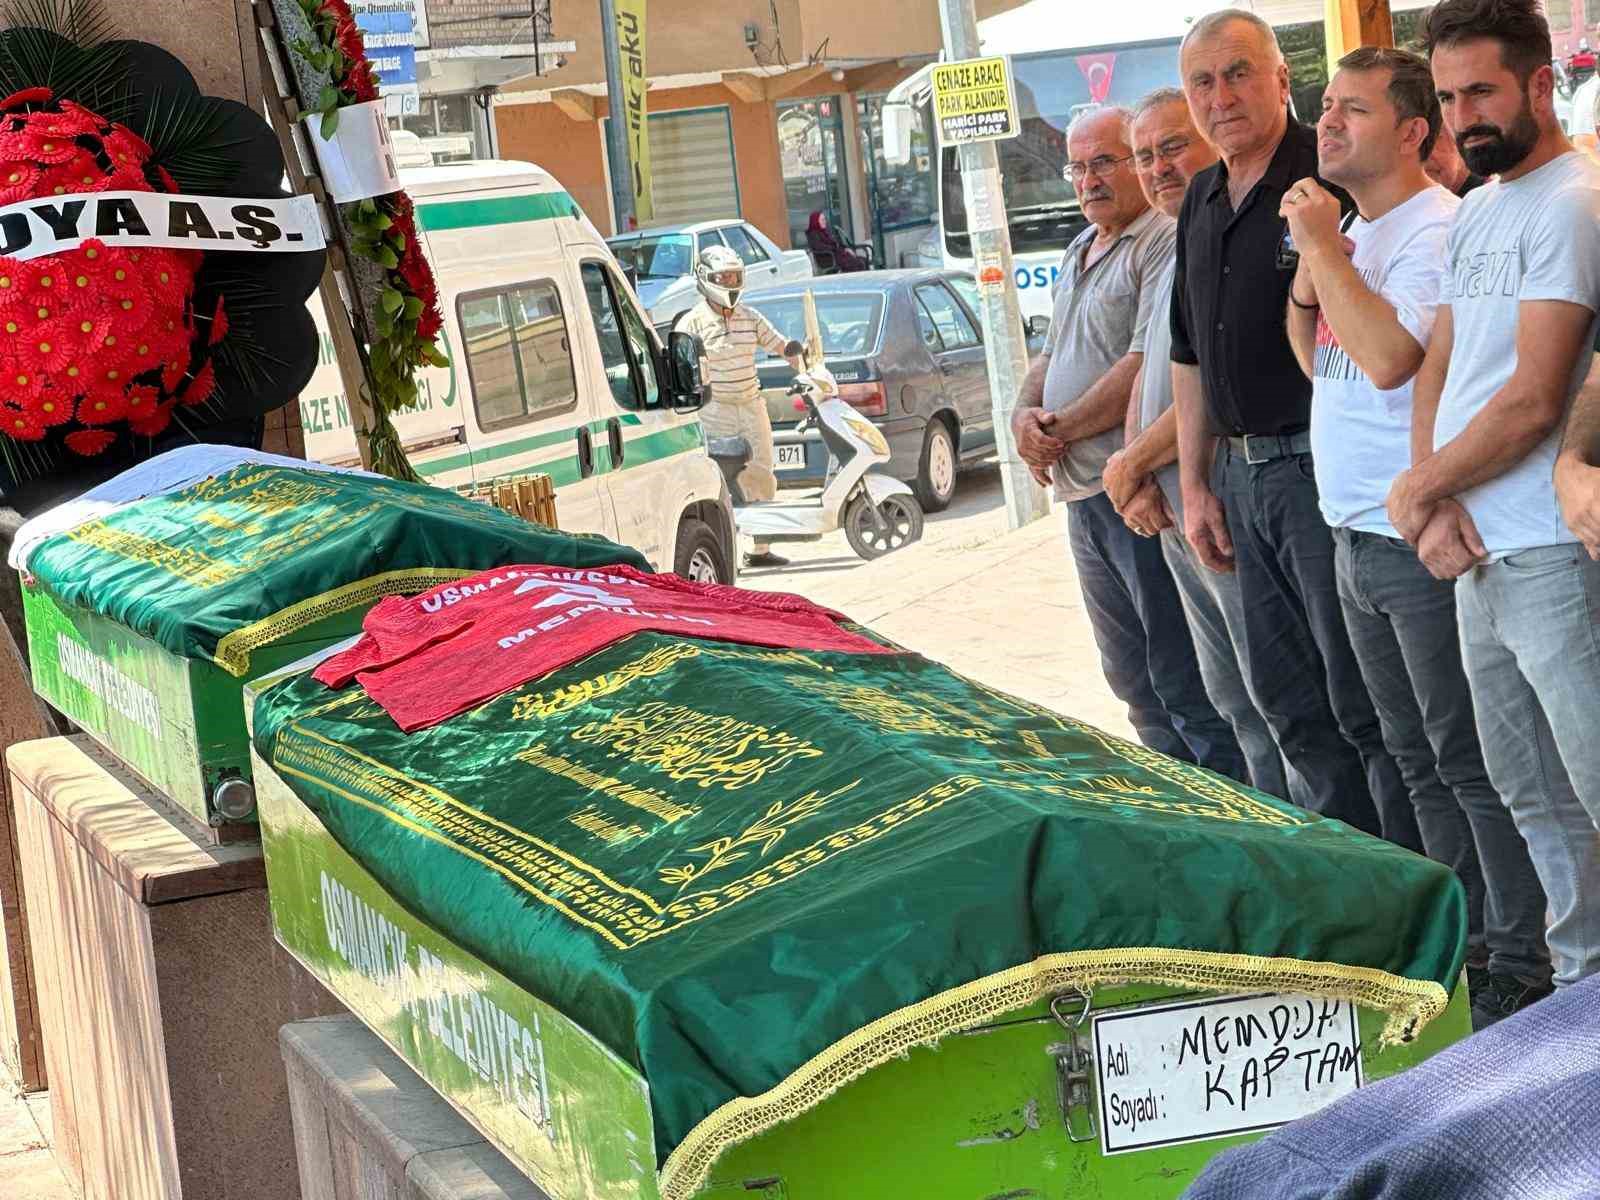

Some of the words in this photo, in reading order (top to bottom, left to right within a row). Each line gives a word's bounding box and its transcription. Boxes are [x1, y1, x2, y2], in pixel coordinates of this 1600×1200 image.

[936, 67, 971, 91] CENAZE
[974, 63, 1003, 86] ARACI
[939, 94, 963, 114] PARK
[964, 89, 1007, 111] ALANIDIR
[977, 111, 1007, 123] PARK
[950, 124, 1002, 139] YAPILMAZ
[168, 200, 304, 249] A.Ş.
[1106, 1042, 1130, 1078] Adı
